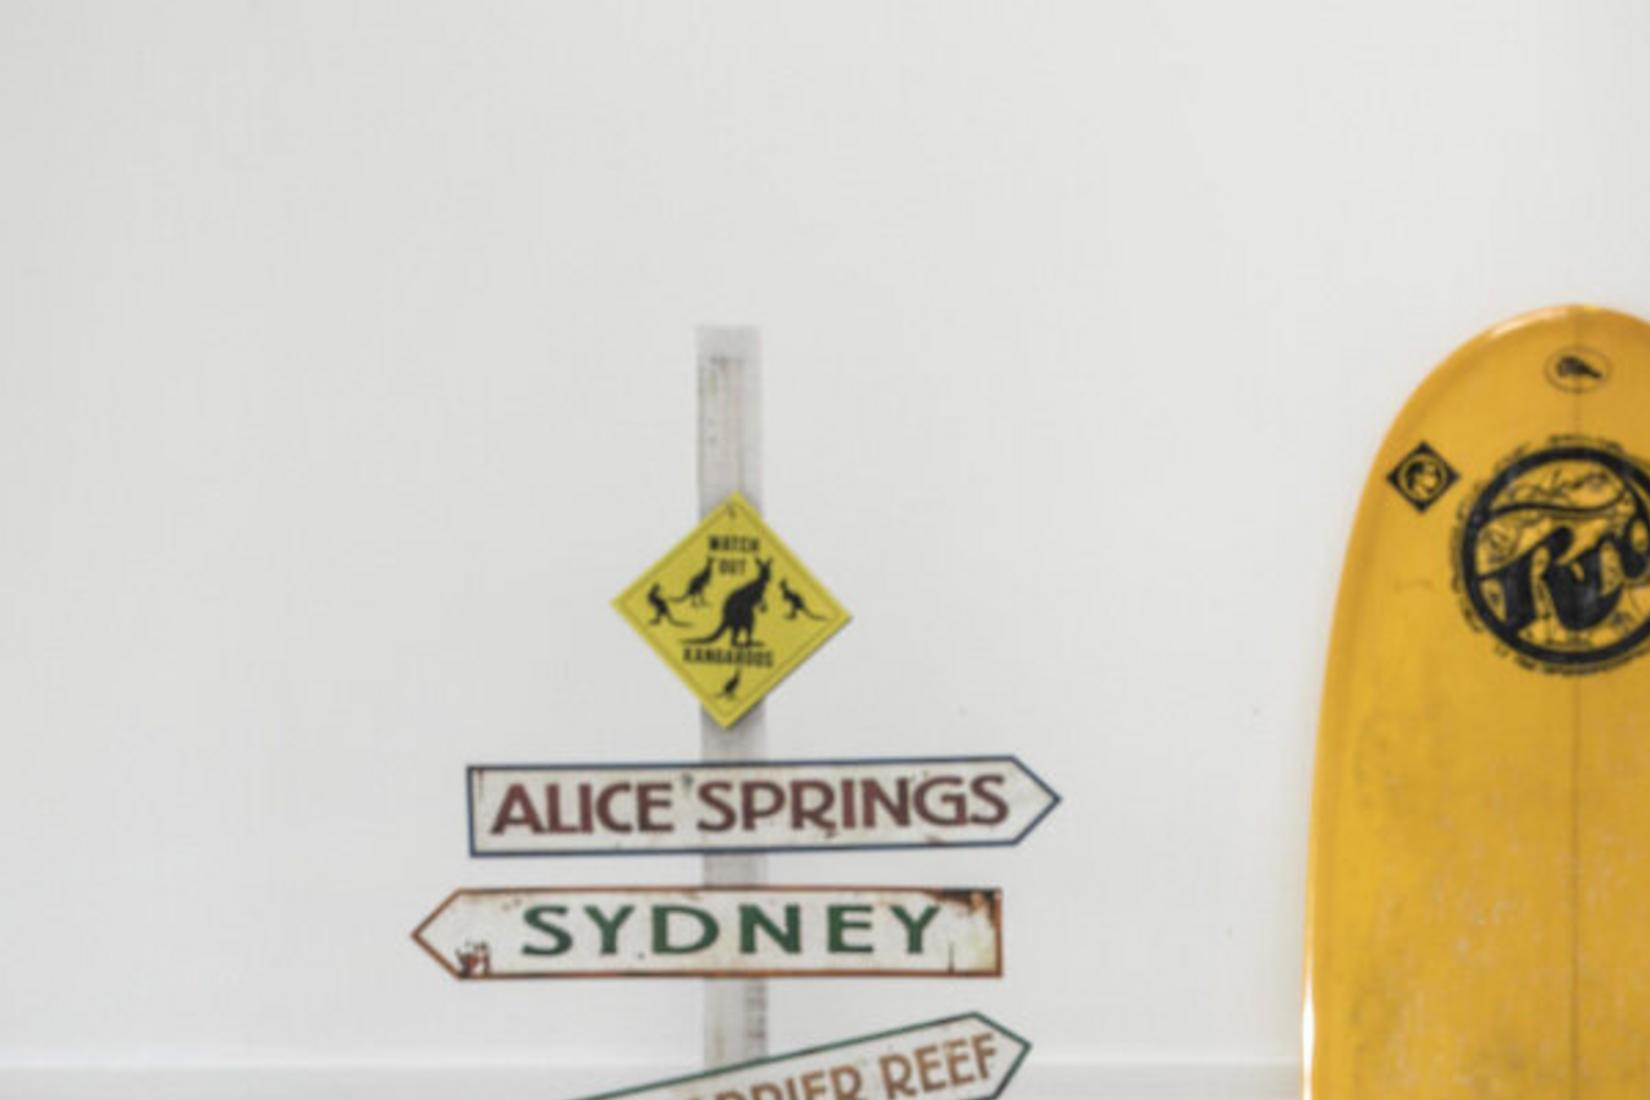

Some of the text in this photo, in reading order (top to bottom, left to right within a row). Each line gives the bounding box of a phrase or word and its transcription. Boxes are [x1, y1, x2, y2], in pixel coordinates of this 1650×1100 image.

[490, 775, 1009, 835] ALICE SPRINGS
[521, 903, 941, 956] SYDNEY
[878, 1032, 998, 1100] REEF
